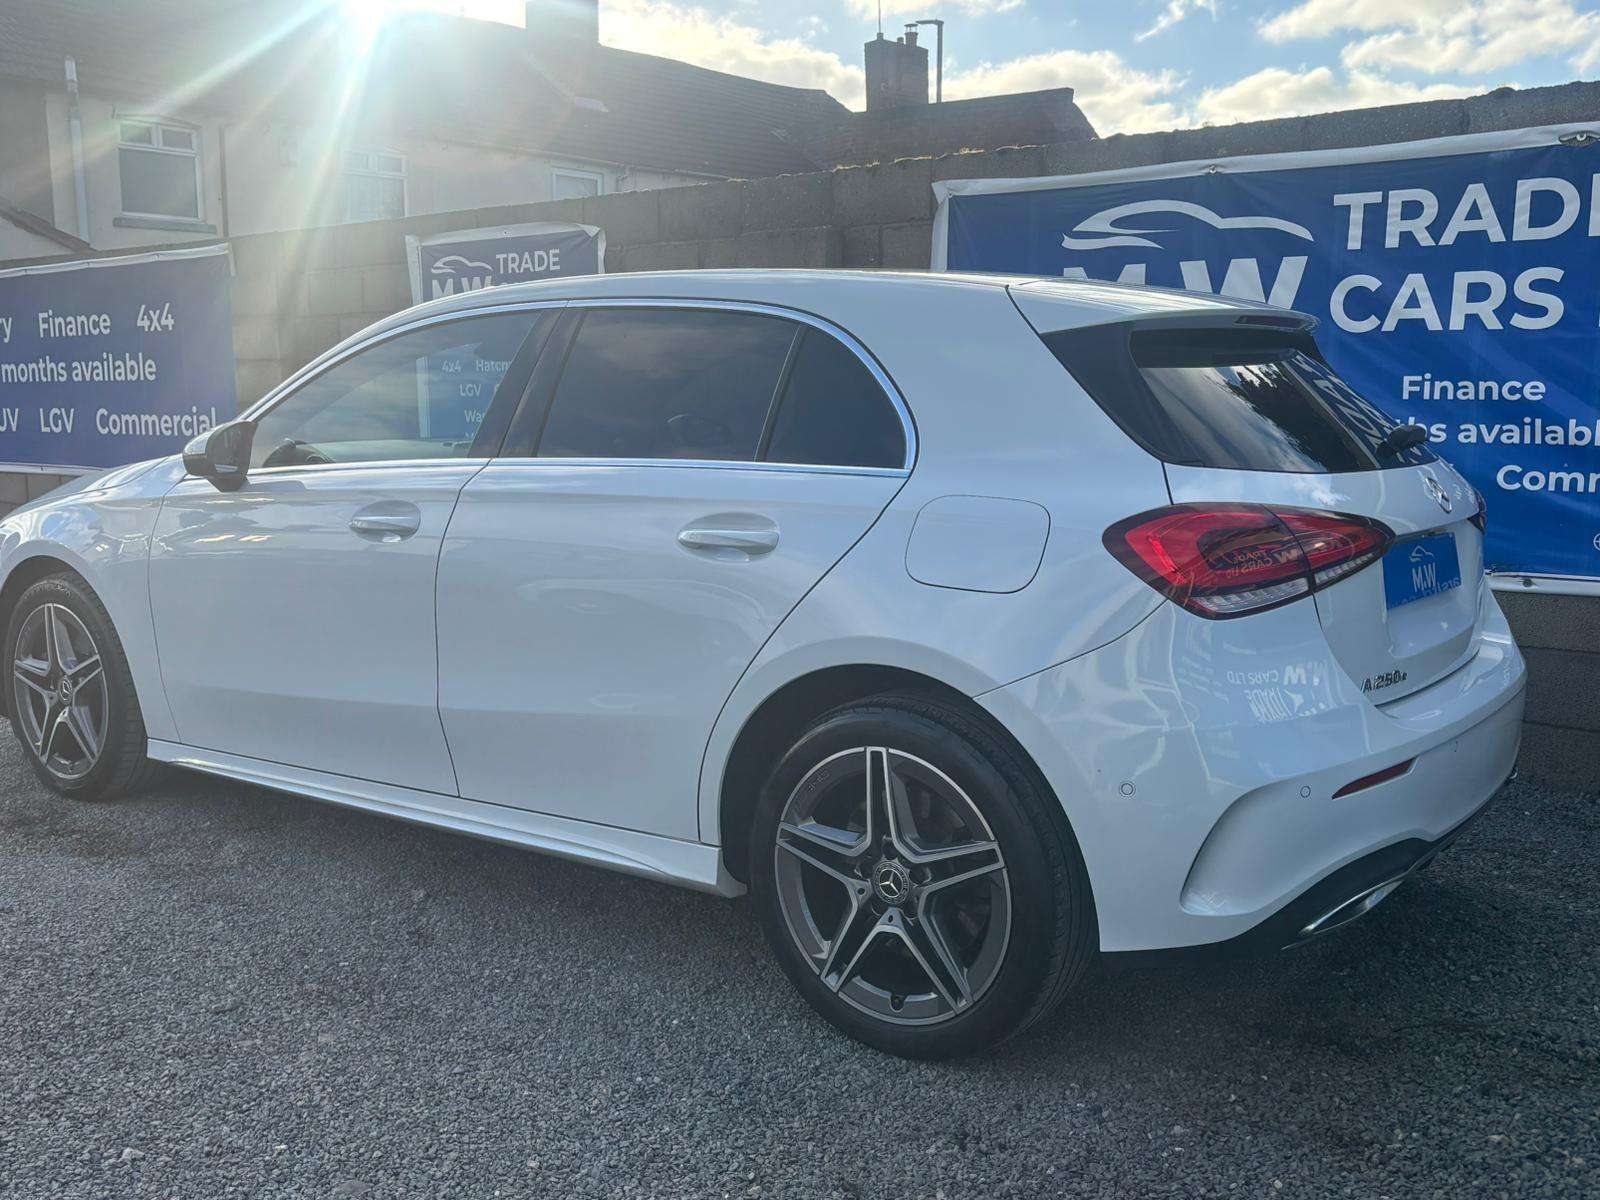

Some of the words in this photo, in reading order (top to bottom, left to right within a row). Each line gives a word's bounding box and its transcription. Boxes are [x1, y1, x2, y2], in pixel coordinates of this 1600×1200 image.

[1334, 173, 1600, 250] TRAD
[495, 248, 561, 275] TRADE
[1329, 266, 1565, 333] CARS
[38, 309, 112, 338] Finance
[136, 302, 175, 332] 4x4
[1, 355, 68, 382] months
[71, 352, 157, 382] available
[441, 359, 462, 373] 4x4
[459, 383, 482, 397] LGV
[1402, 372, 1546, 401] Finance
[39, 407, 75, 433] LGV
[95, 405, 216, 437] Commercial
